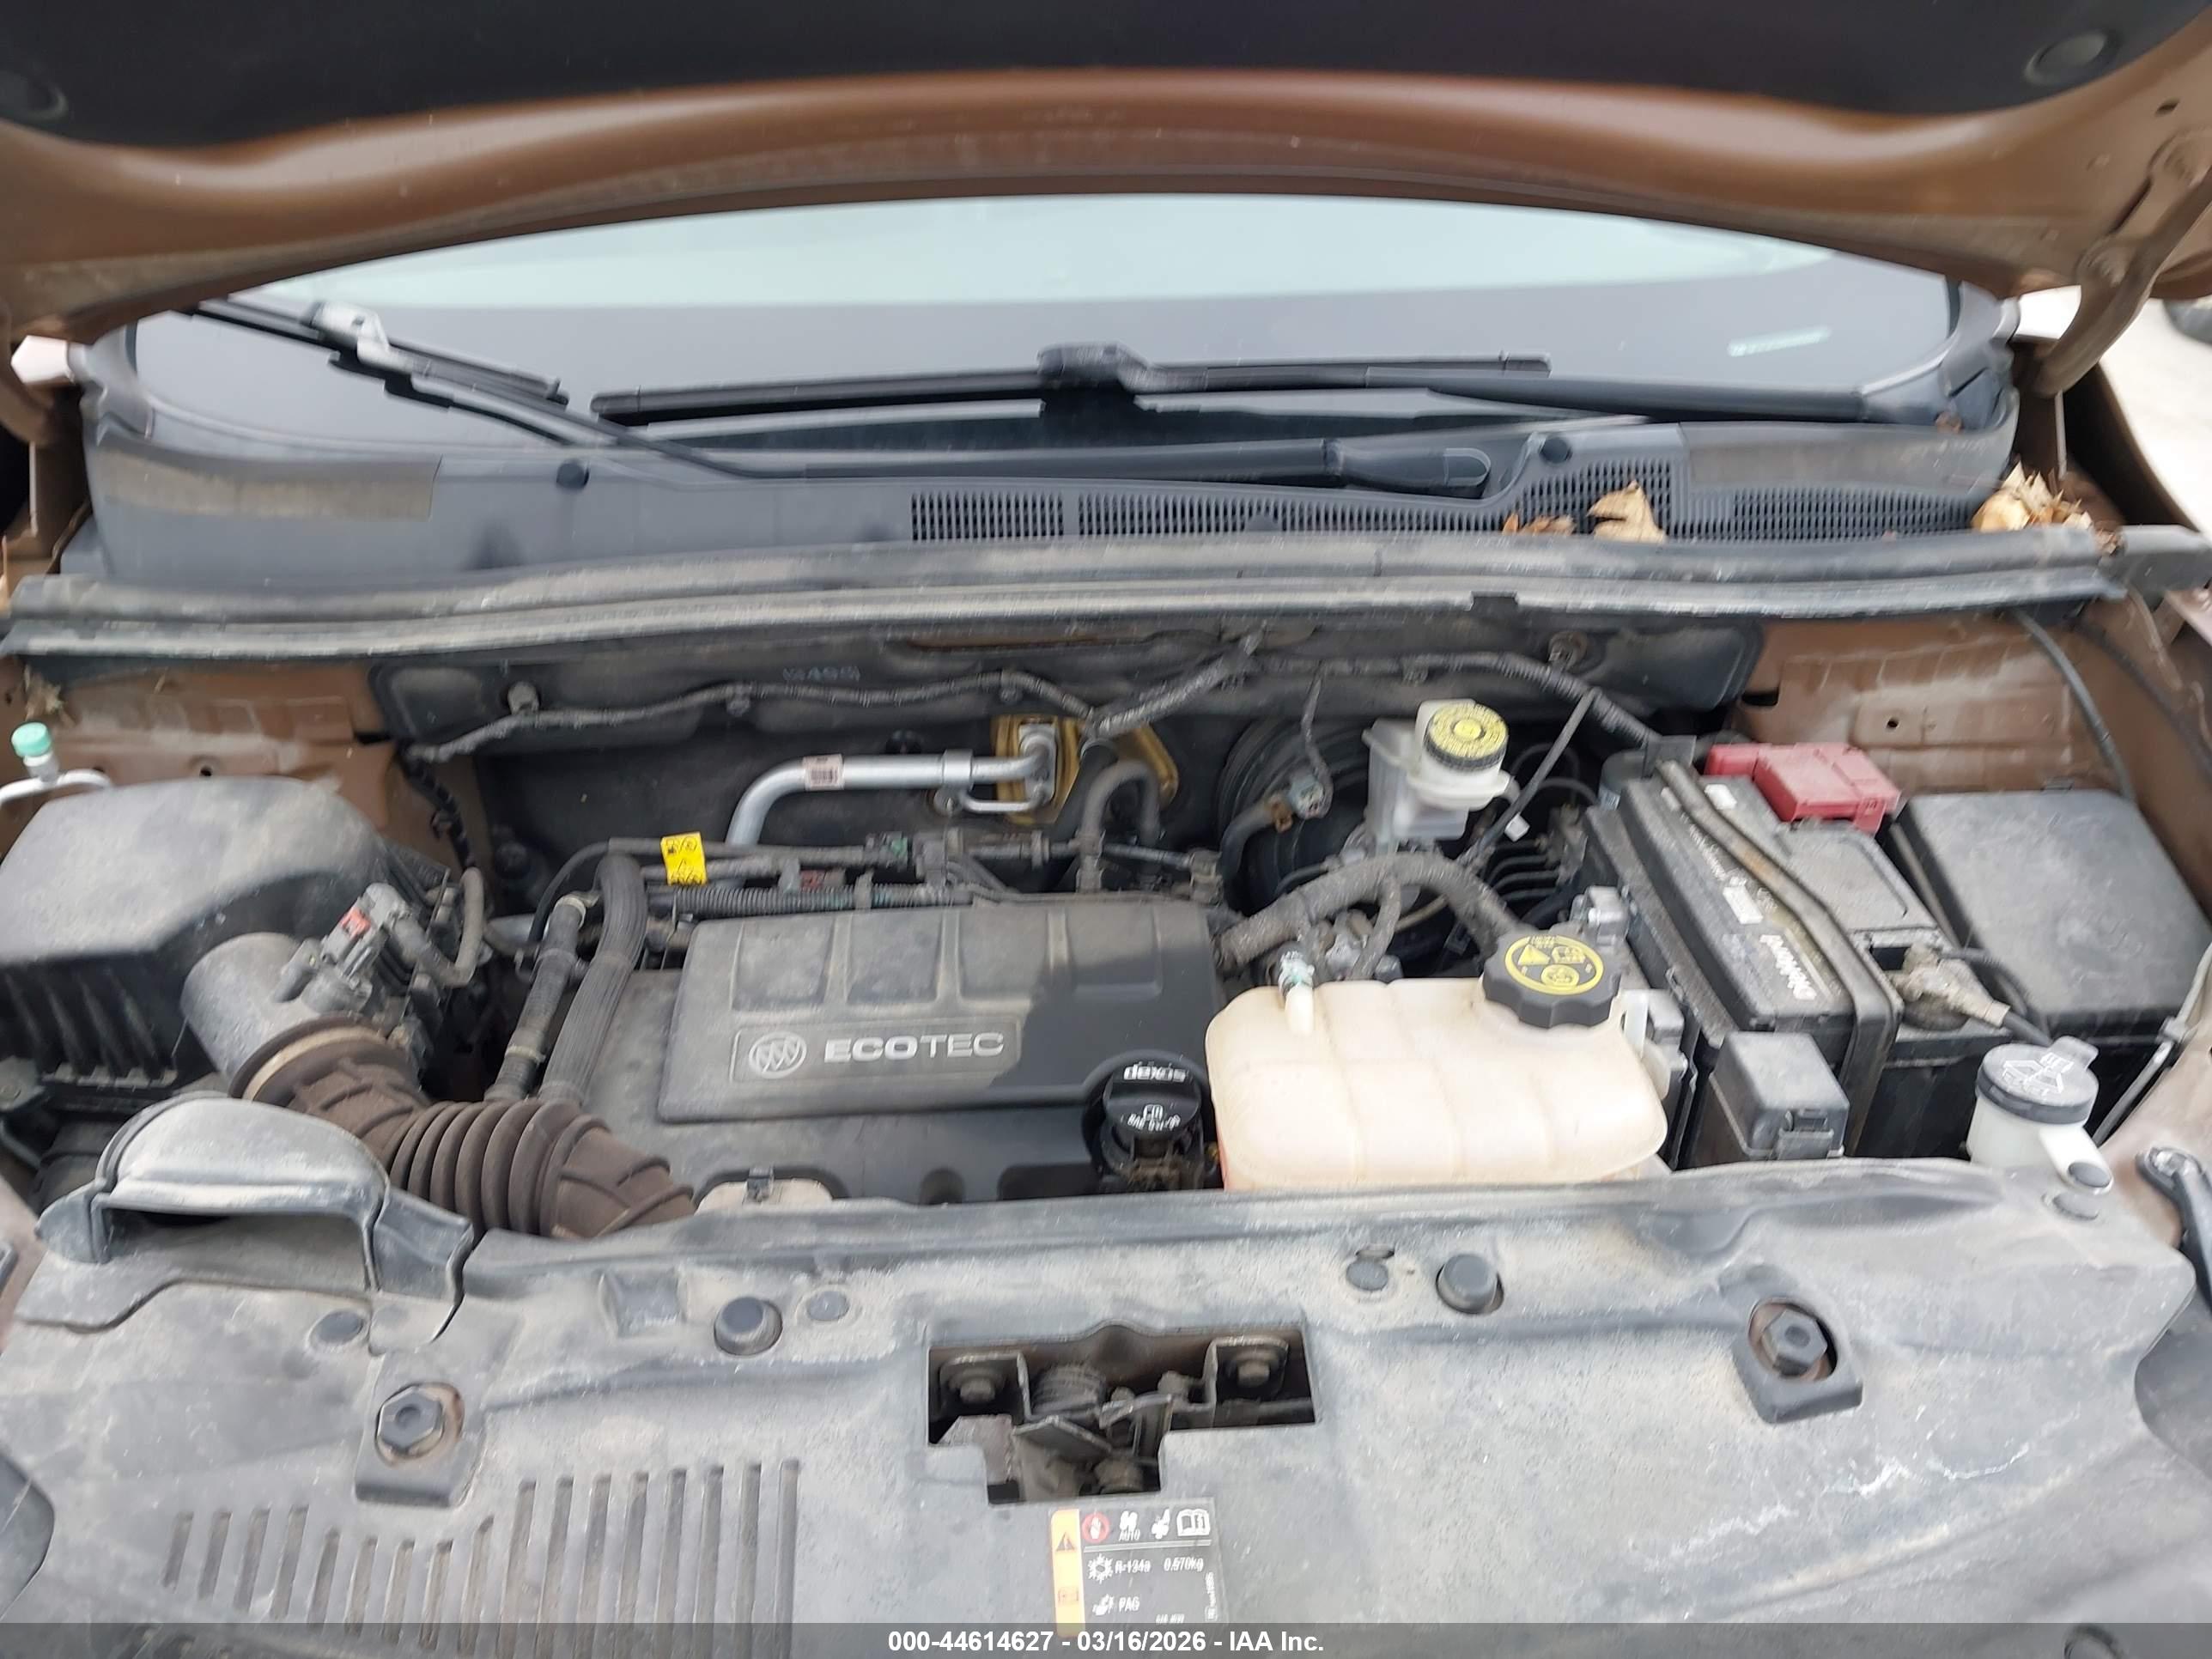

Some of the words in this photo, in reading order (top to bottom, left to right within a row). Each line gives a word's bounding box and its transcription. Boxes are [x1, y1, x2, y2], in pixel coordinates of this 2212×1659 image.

[824, 1032, 1004, 1063] ECOTEC
[1123, 1062, 1186, 1083] dexos
[1118, 1596, 1140, 1612] PAG
